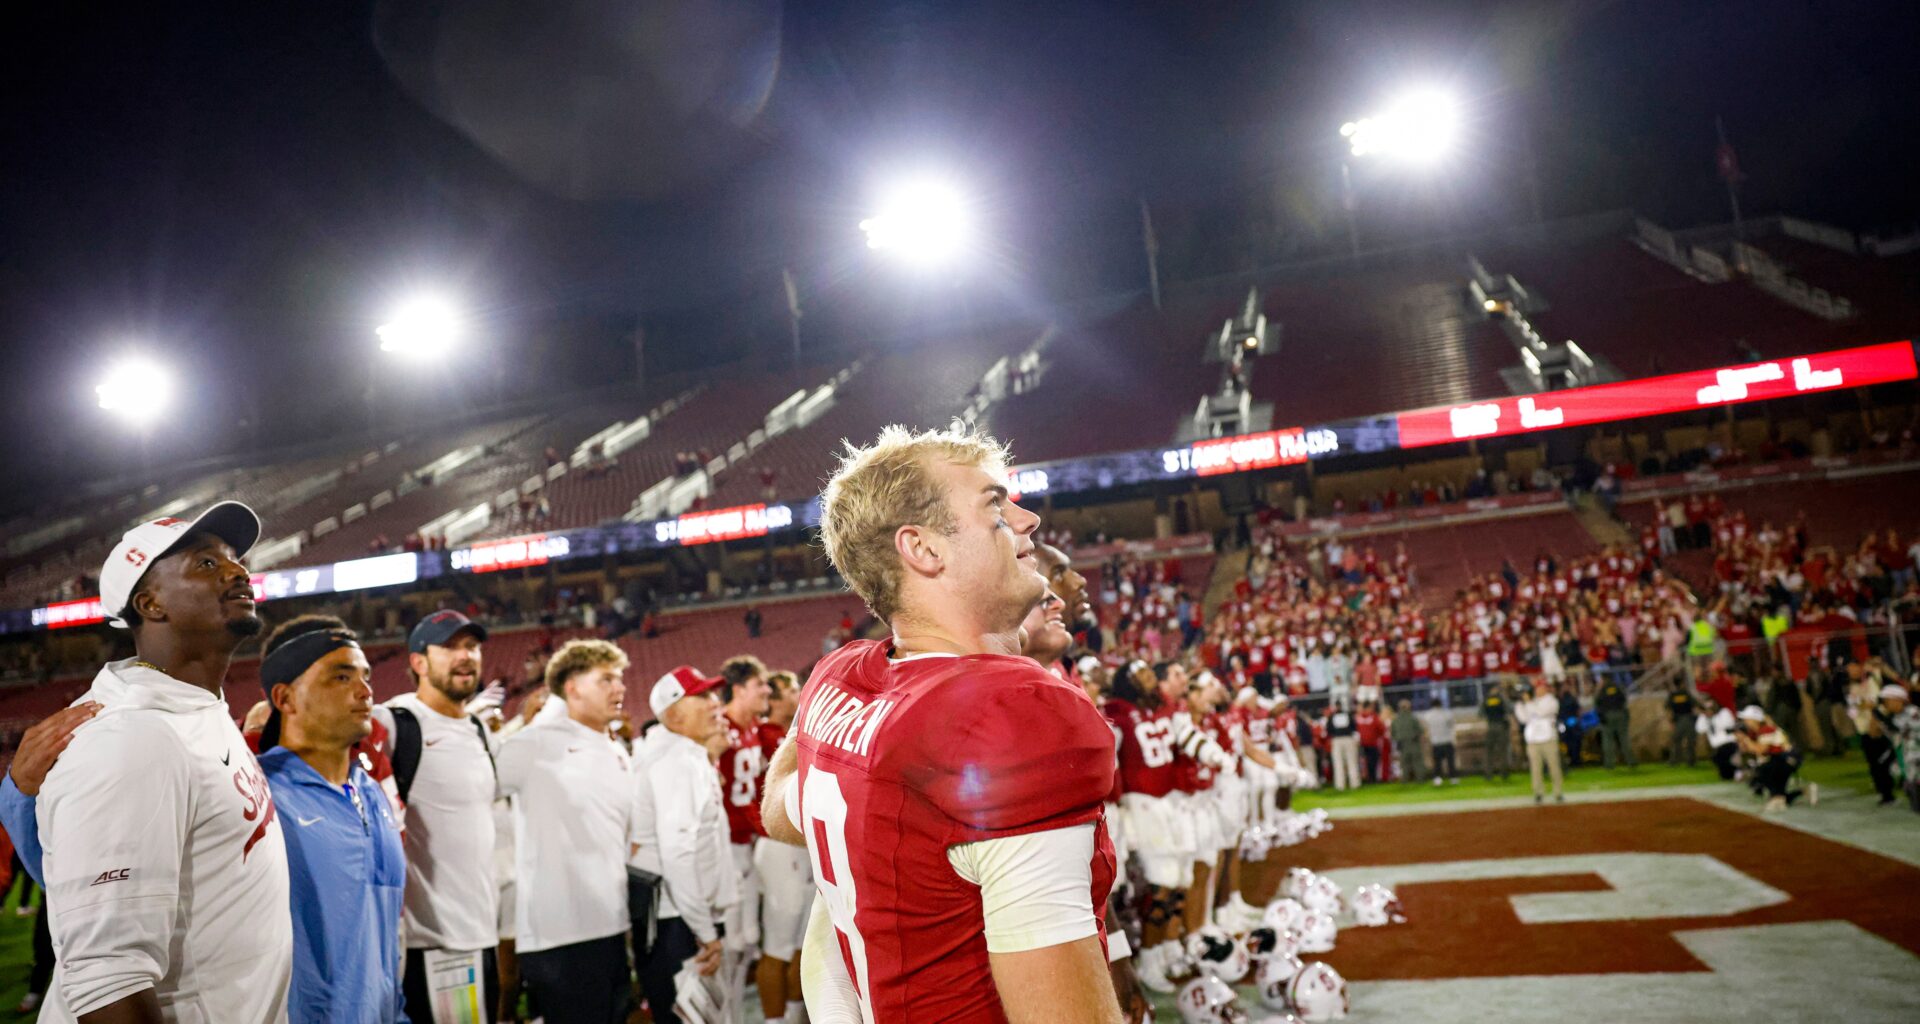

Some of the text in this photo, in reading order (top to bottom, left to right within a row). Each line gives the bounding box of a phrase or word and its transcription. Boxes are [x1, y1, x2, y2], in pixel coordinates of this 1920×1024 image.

[803, 682, 895, 758] WARREN
[1134, 716, 1177, 769] 62
[92, 867, 131, 885] ACC
